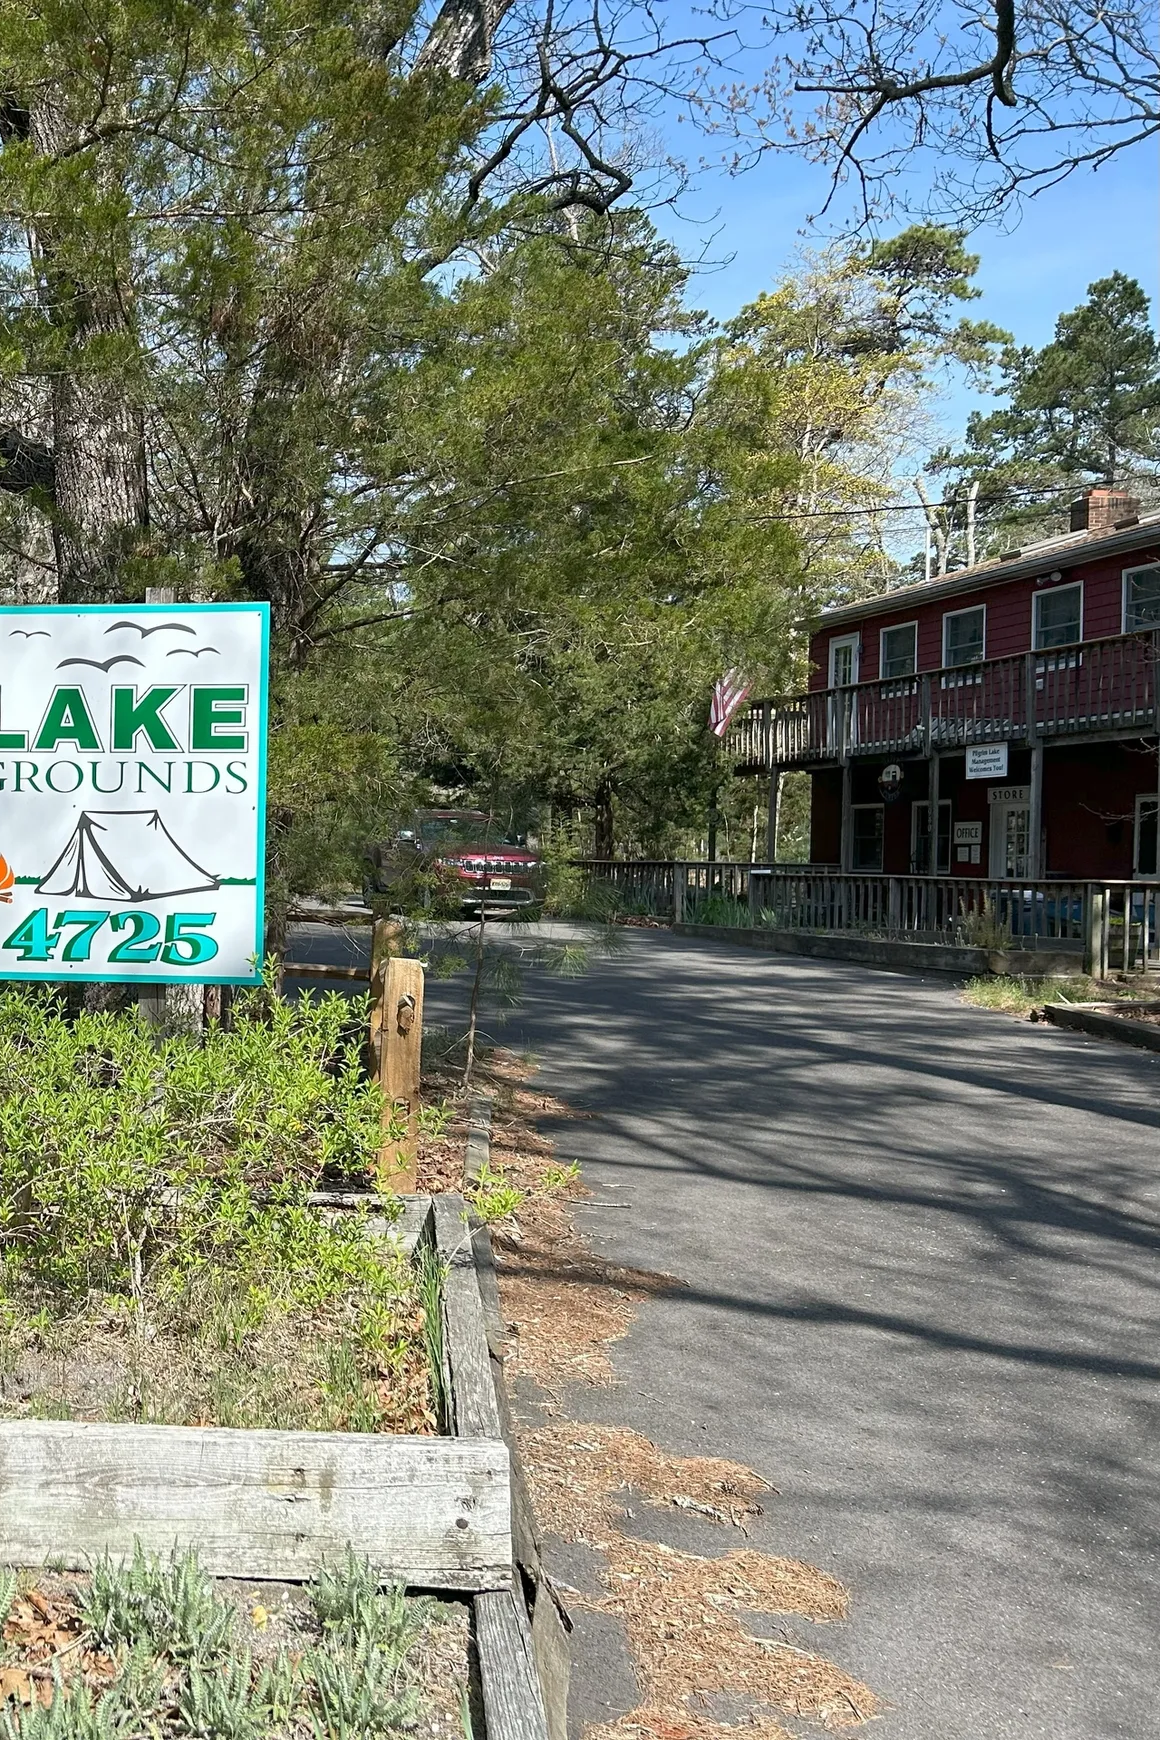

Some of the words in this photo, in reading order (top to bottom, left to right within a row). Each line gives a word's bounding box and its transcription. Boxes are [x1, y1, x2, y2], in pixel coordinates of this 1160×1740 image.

[972, 749, 988, 757] Pilgrim
[972, 757, 1001, 765] Management
[992, 789, 1024, 800] STORE
[957, 827, 979, 839] OFFICE
[2, 907, 219, 966] 4725
